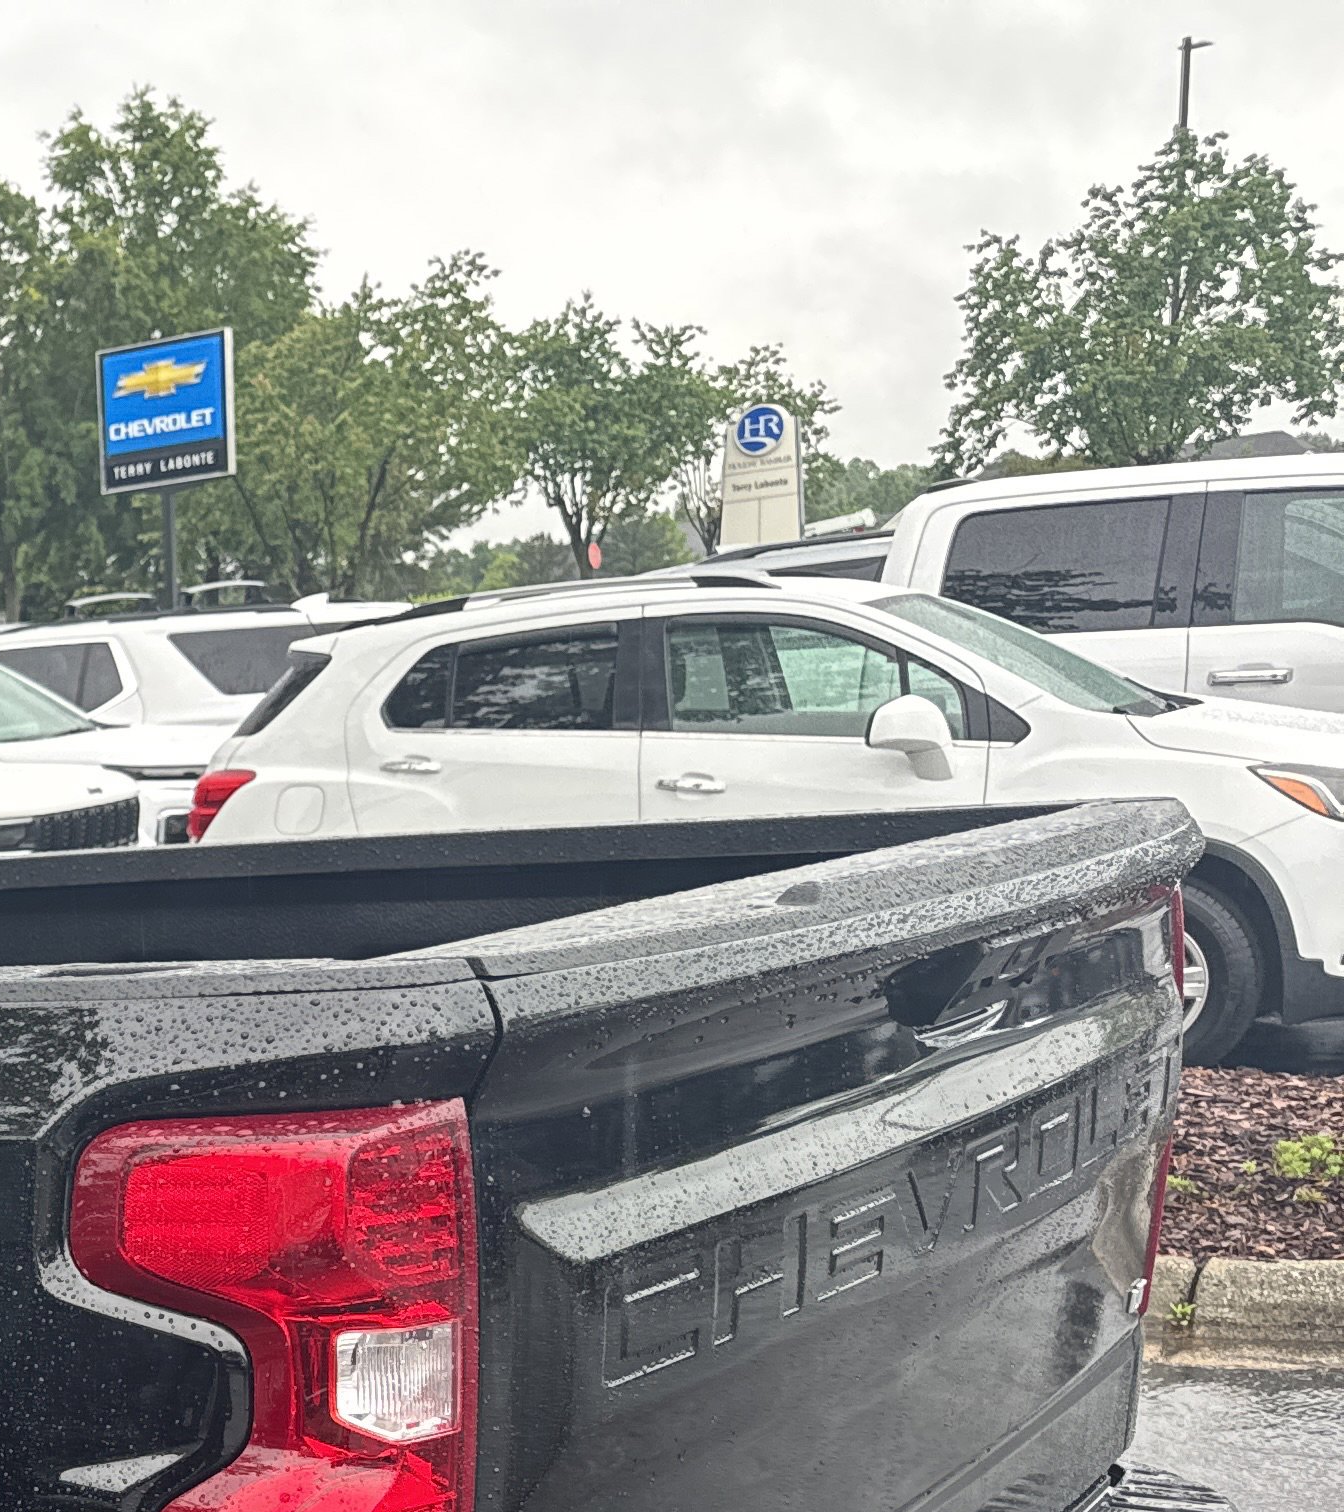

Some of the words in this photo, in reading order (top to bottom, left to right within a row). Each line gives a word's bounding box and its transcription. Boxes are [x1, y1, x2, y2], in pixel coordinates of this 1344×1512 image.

[108, 406, 215, 441] CHEVROLET
[743, 413, 781, 438] HR
[112, 461, 153, 480] TERRY
[159, 450, 215, 472] LABONTE
[602, 1042, 1180, 1389] CHEVROLET
